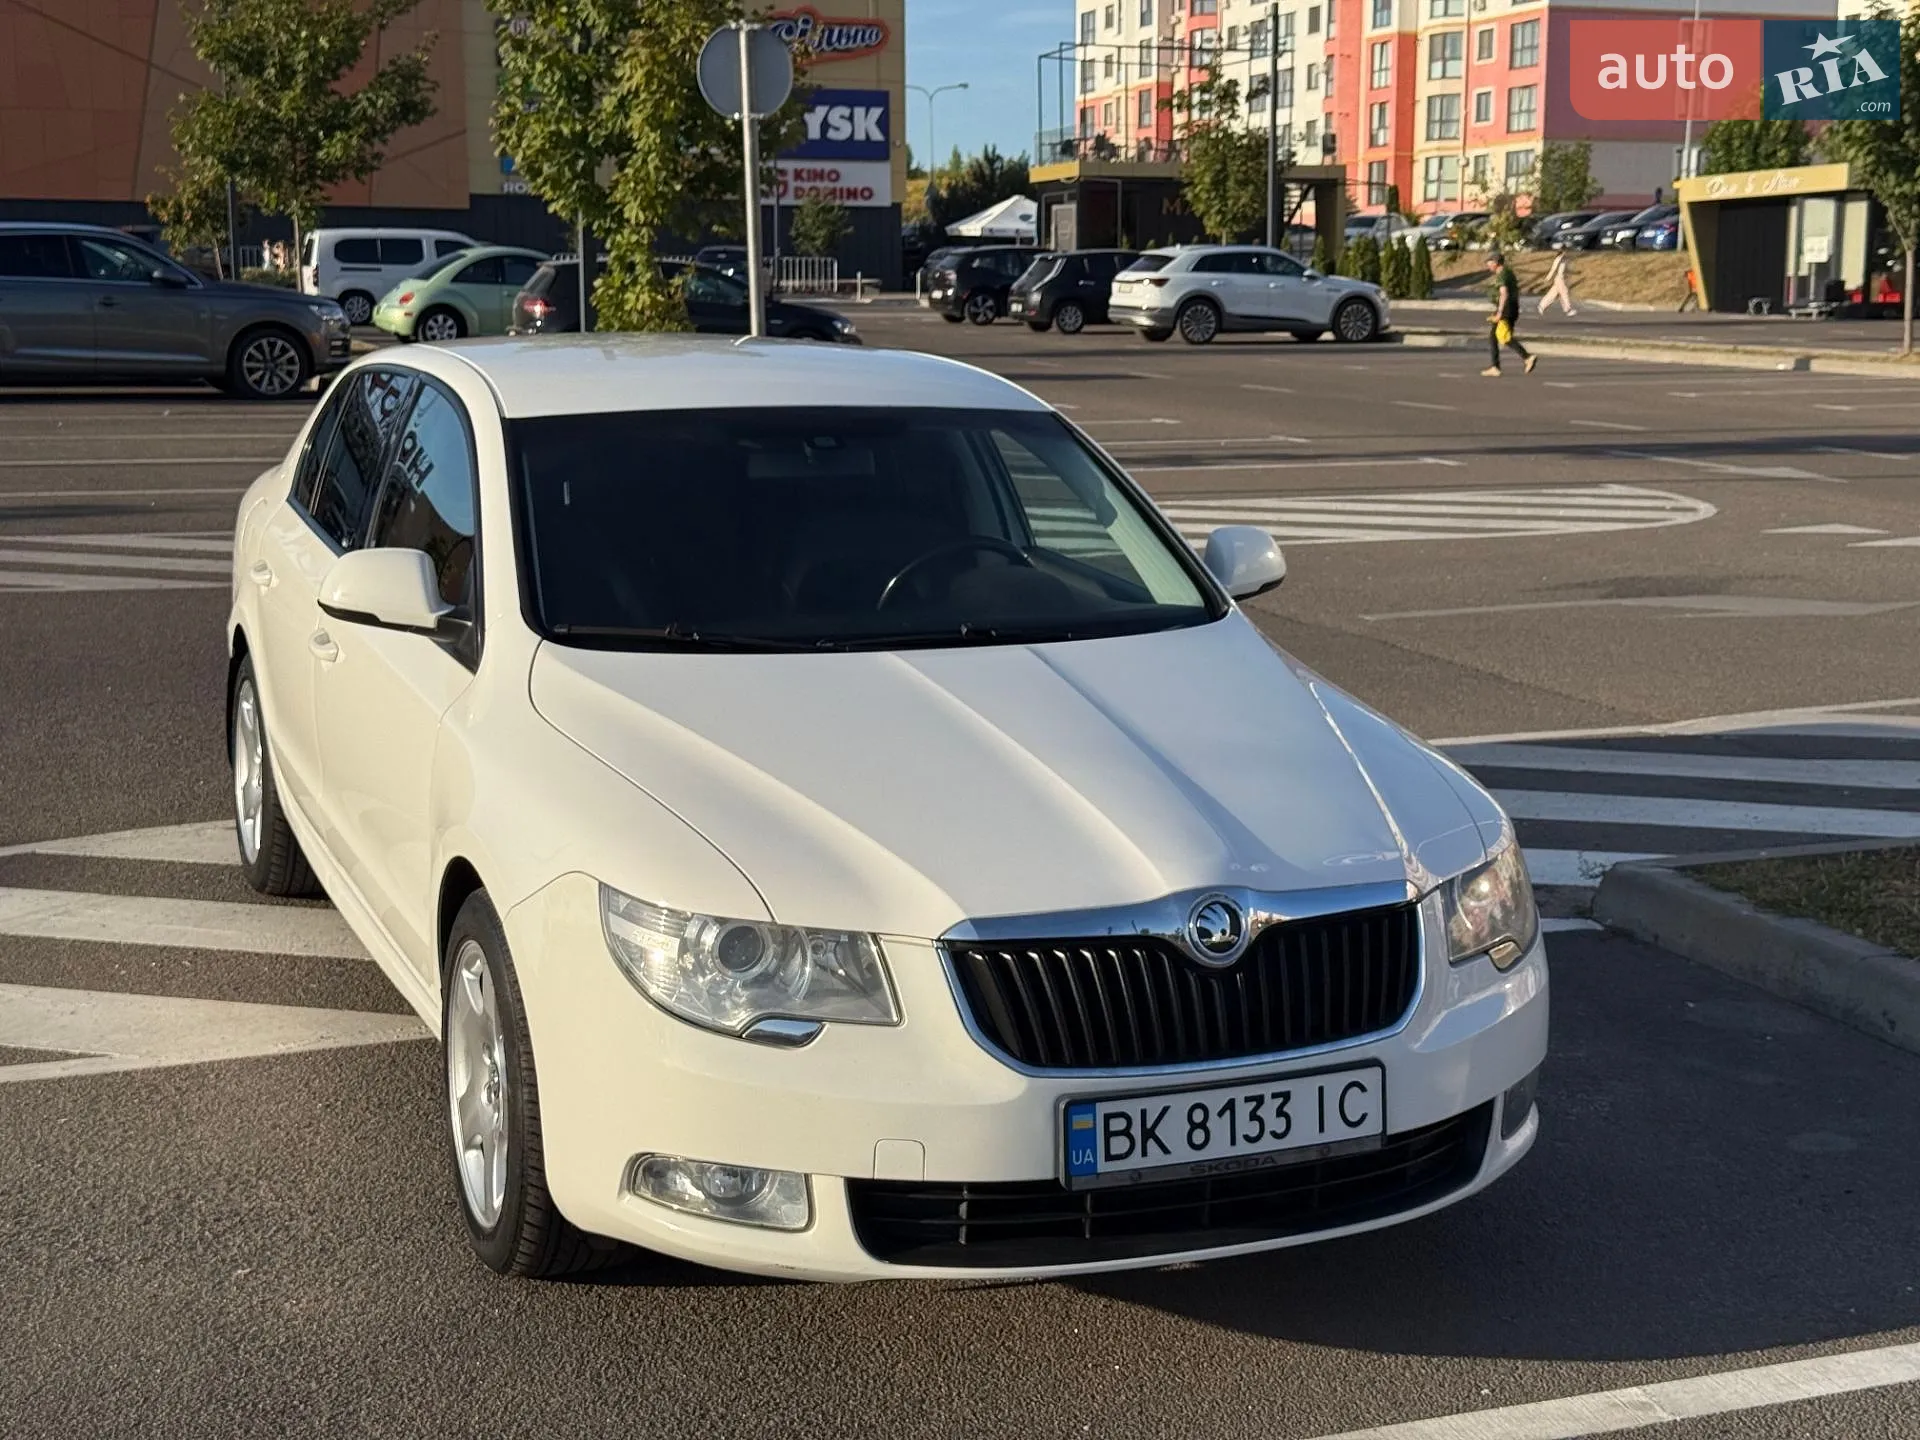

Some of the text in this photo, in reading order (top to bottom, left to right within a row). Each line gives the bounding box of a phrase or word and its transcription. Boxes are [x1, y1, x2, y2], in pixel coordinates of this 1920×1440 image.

[1103, 1080, 1369, 1163] BK 8133 IC
[1072, 1148, 1094, 1166] UA
